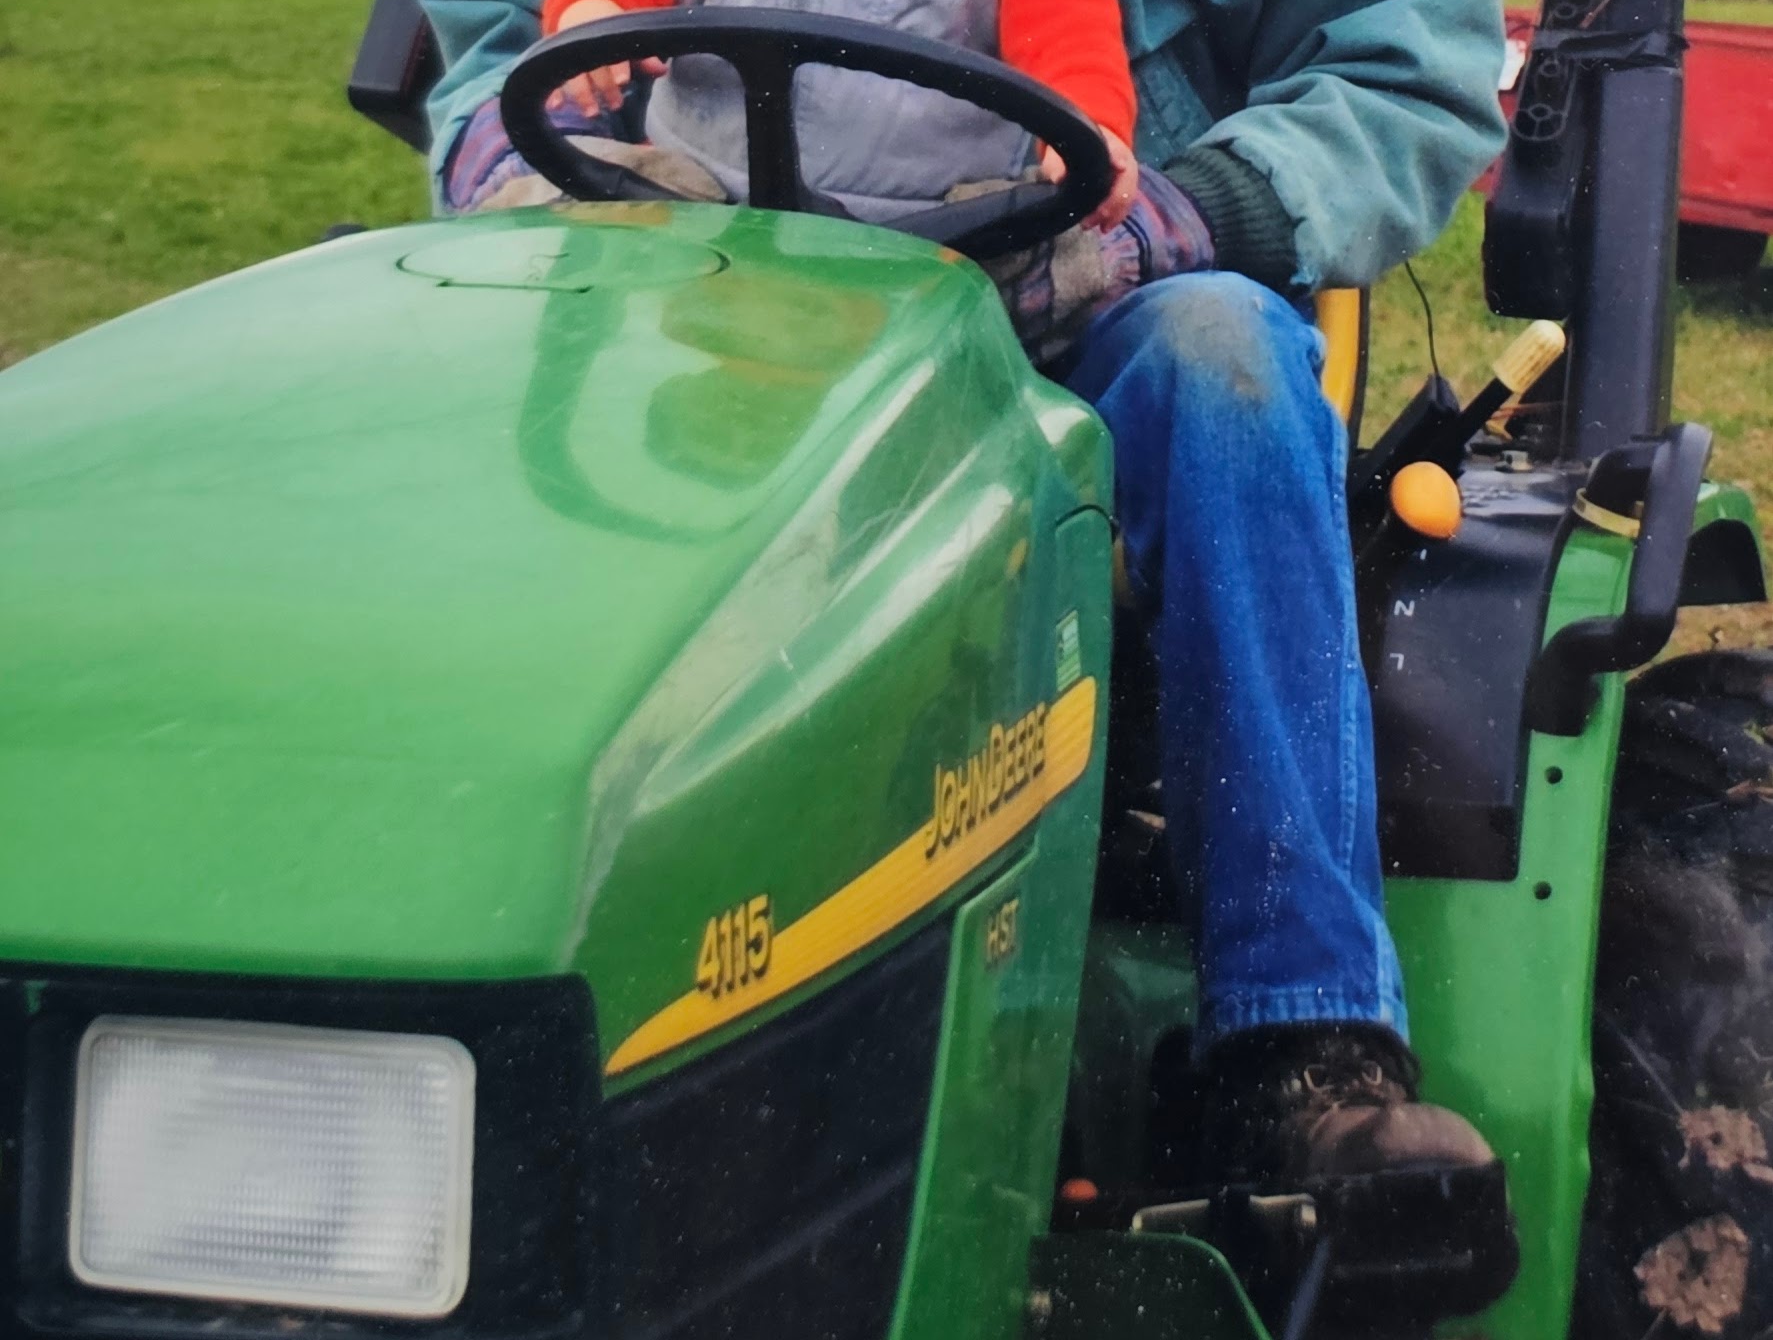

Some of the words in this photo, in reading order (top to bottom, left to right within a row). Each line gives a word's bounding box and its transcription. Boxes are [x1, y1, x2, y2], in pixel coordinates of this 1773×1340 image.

[1393, 599, 1415, 617] N
[696, 893, 772, 998] 4115
[985, 898, 1020, 968] HST
